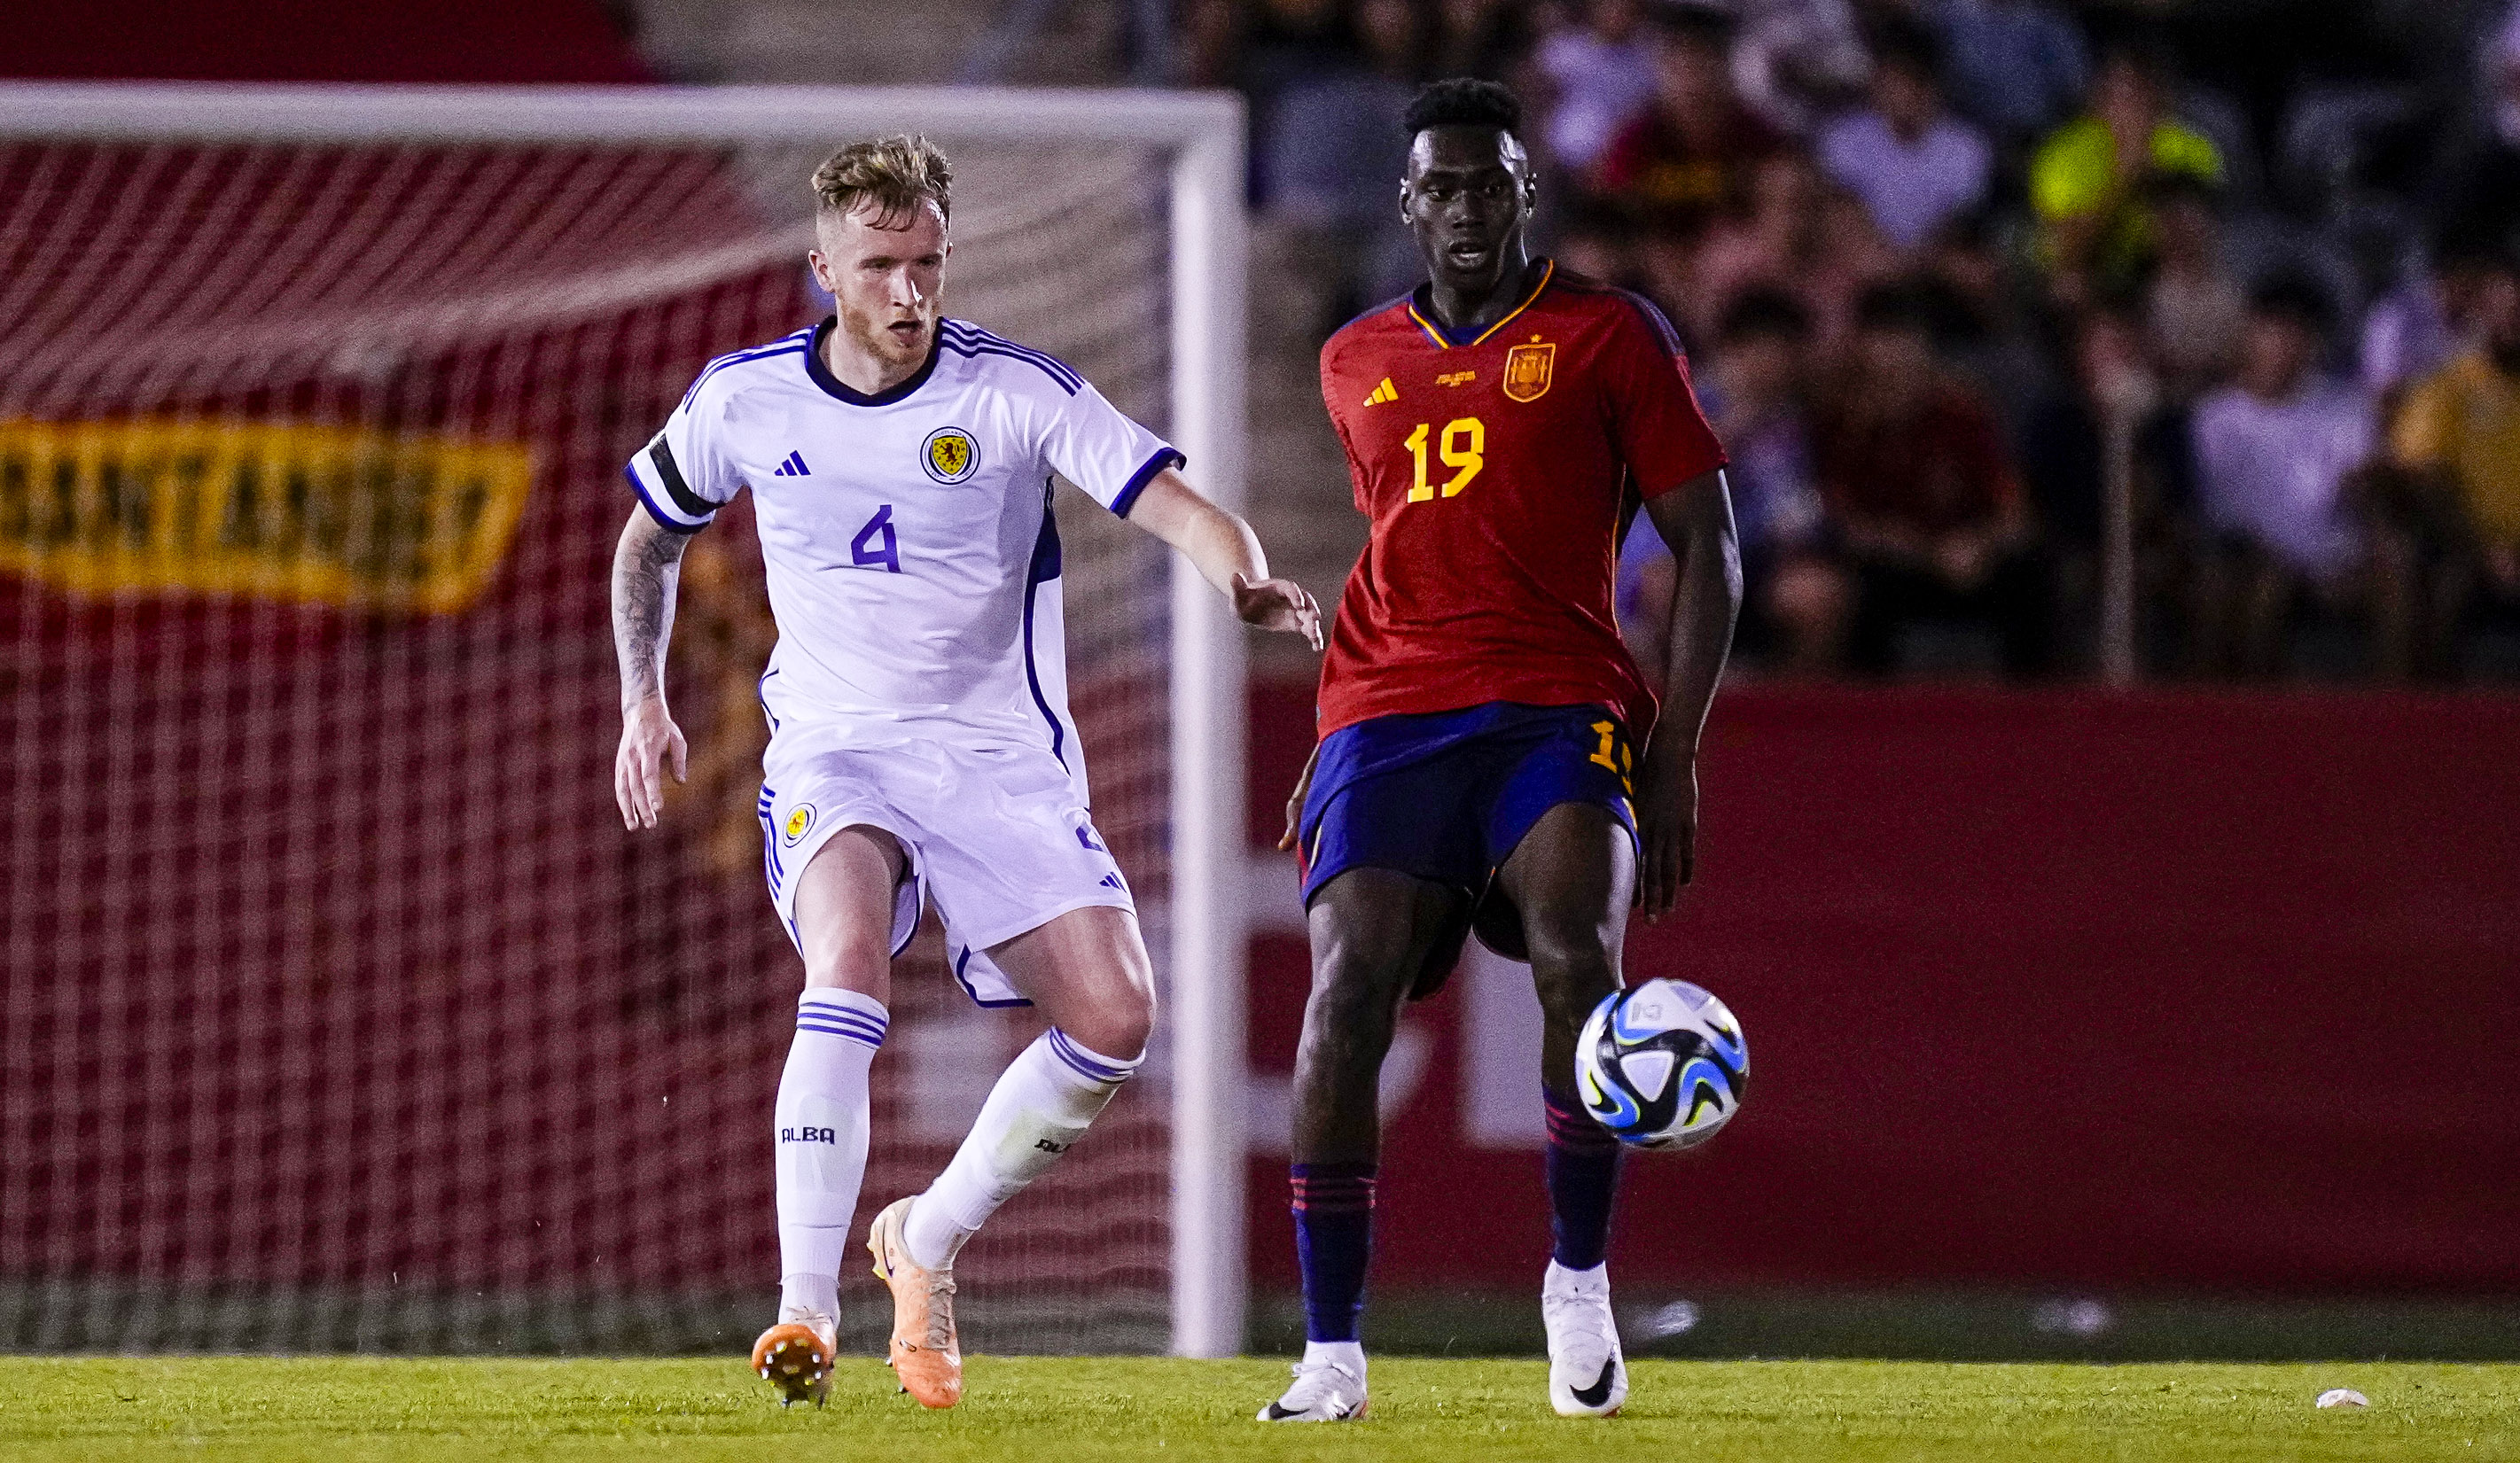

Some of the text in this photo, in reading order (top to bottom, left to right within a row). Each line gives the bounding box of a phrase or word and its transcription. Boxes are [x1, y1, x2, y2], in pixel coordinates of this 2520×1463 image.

[1403, 416, 1486, 504] 19
[850, 504, 901, 574] 4
[781, 1126, 835, 1146] ALBA
